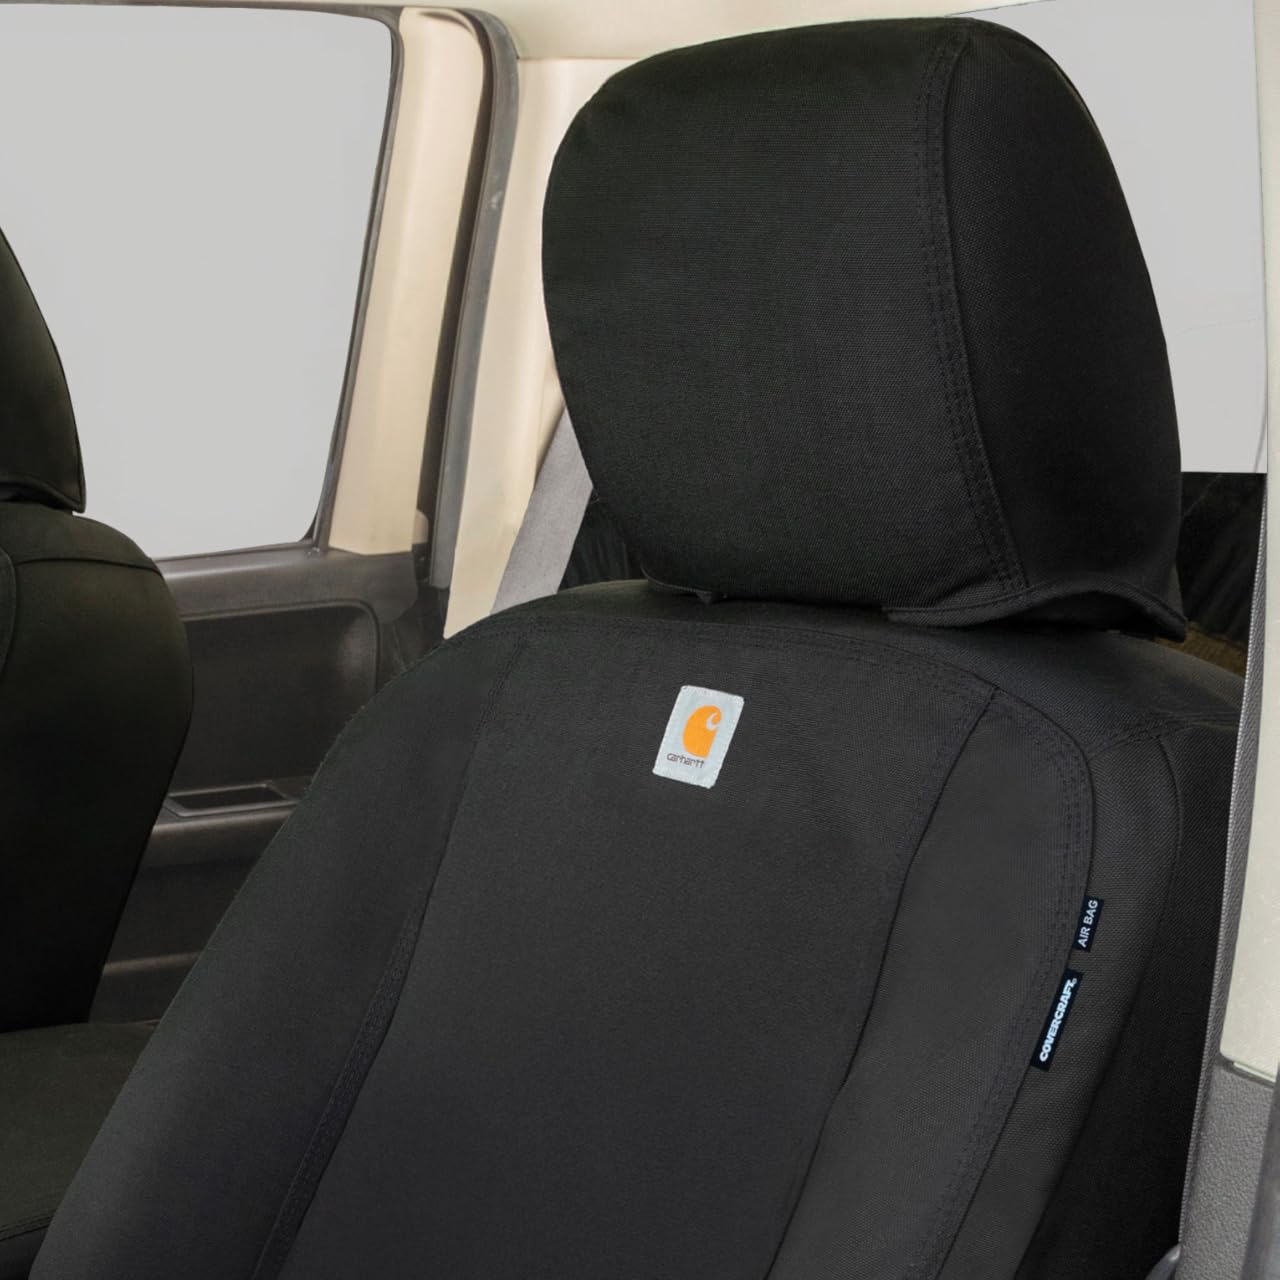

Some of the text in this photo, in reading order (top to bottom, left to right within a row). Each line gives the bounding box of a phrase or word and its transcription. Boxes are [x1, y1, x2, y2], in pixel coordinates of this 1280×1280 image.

[666, 752, 705, 769] carhartt
[1077, 899, 1098, 948] AIR BAG
[1039, 977, 1077, 1062] COVERCRAFT
